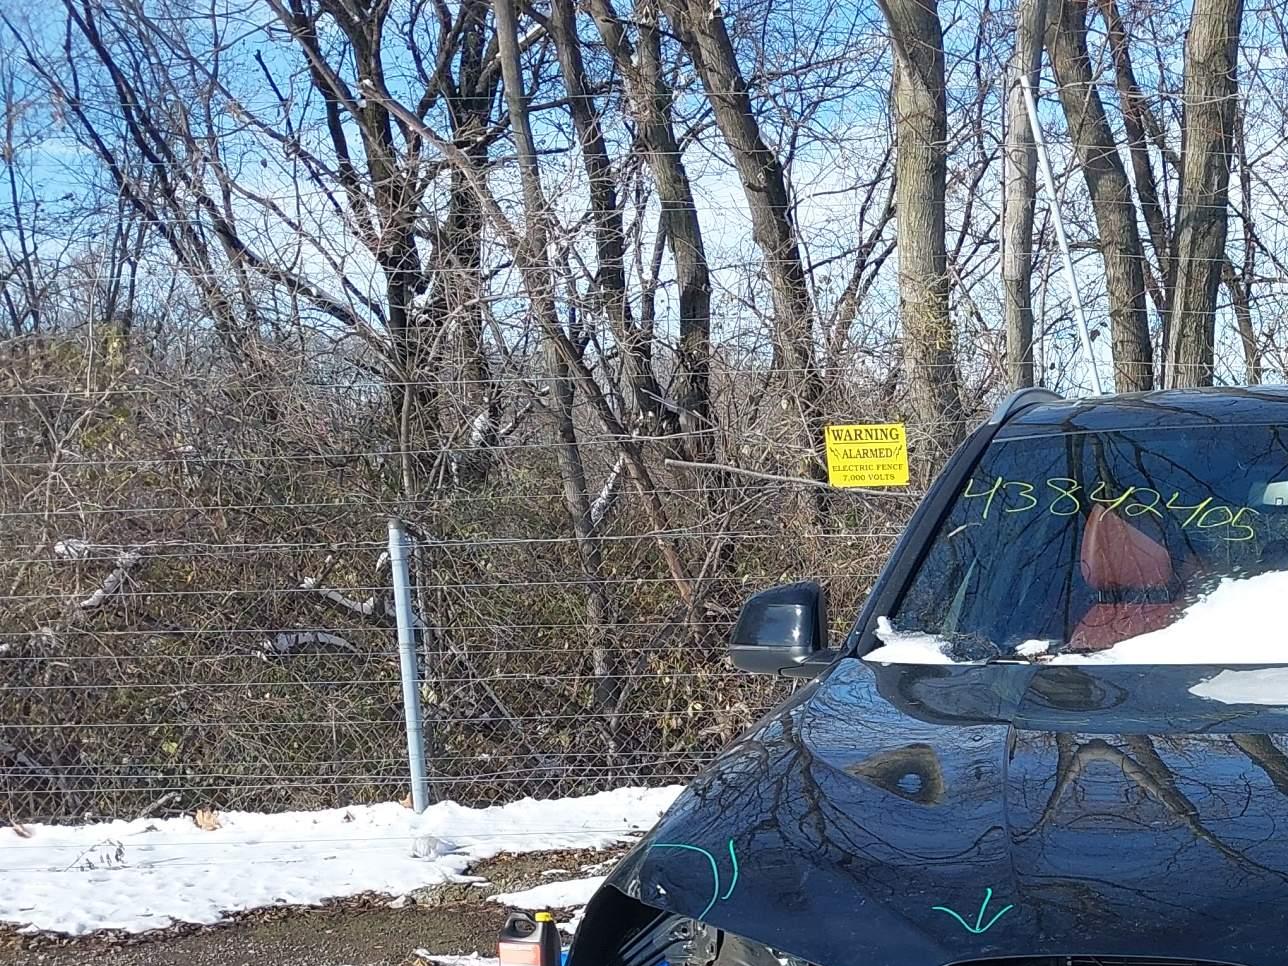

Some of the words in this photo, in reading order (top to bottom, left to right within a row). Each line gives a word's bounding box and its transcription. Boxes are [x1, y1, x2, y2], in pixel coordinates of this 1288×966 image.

[831, 428, 899, 441] WARNING
[842, 448, 893, 459] ALARMED
[832, 464, 874, 472] ELECTRIC
[876, 463, 904, 471] FENCE
[843, 474, 866, 482] 7,000
[868, 473, 895, 481] VOLTS
[964, 476, 1261, 541] 43842405
